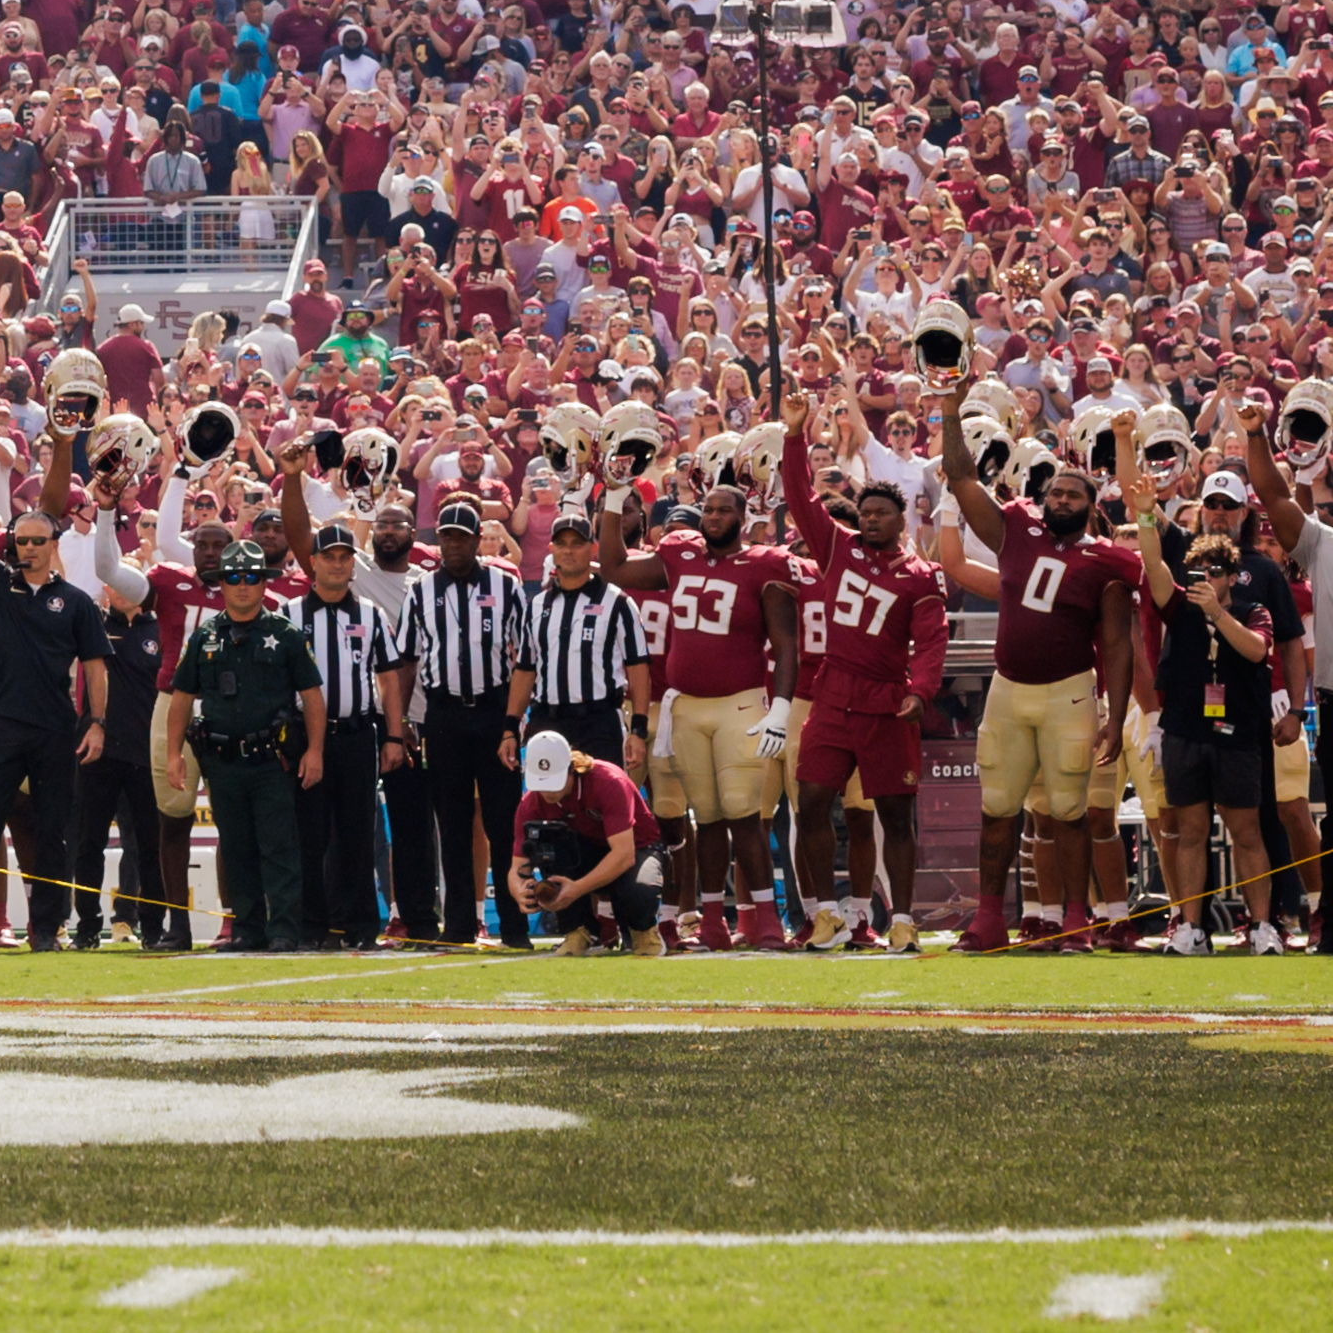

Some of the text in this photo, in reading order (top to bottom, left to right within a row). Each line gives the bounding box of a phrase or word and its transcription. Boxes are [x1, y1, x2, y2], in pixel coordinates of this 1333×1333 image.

[414, 43, 428, 64] 4
[856, 100, 877, 126] 15
[1020, 555, 1067, 614] 0
[436, 595, 445, 607] S
[671, 574, 739, 636] 53
[832, 568, 899, 637] 57
[542, 606, 551, 618] S
[304, 623, 313, 635] S
[483, 618, 492, 633] S
[803, 600, 827, 654] 8
[582, 627, 594, 641] H
[352, 649, 362, 664] C
[931, 762, 980, 778] coach
